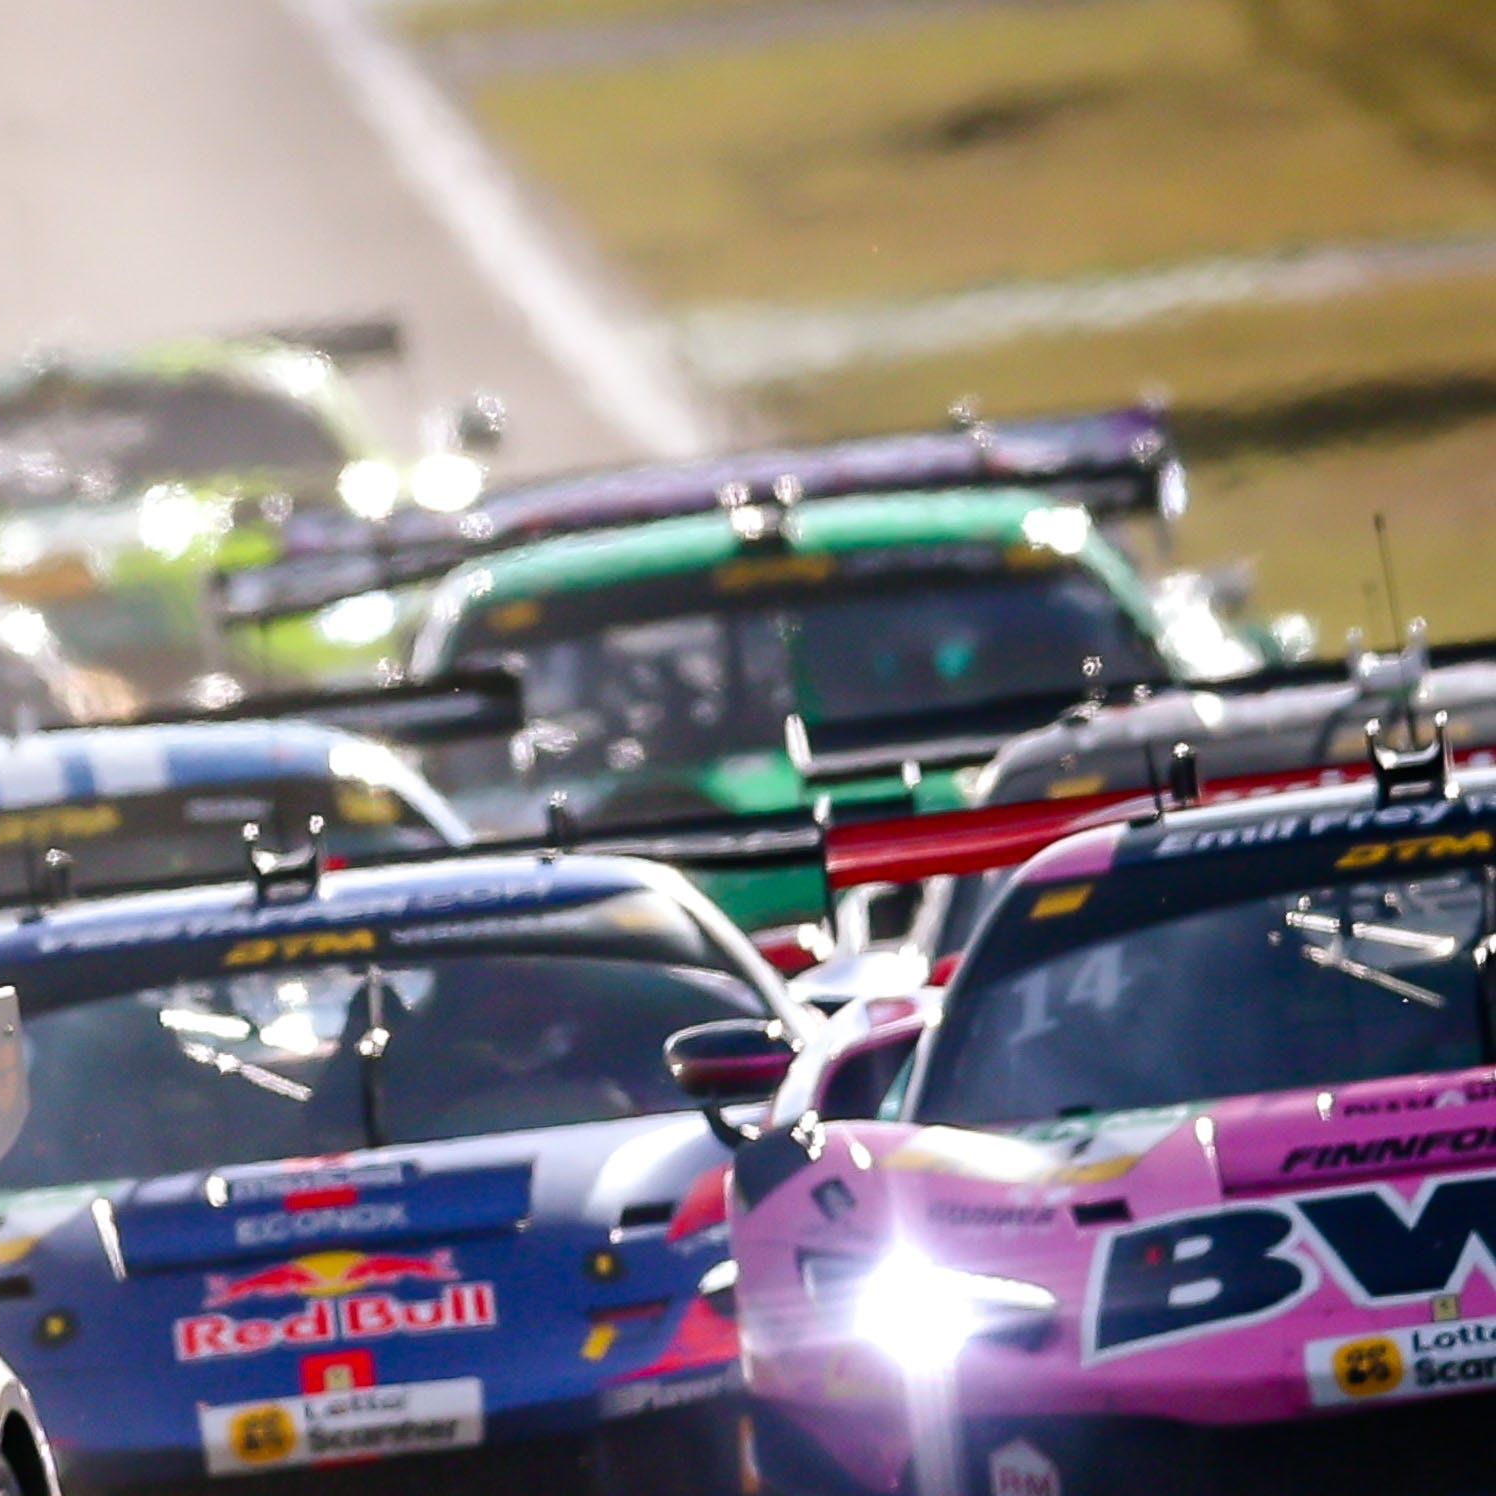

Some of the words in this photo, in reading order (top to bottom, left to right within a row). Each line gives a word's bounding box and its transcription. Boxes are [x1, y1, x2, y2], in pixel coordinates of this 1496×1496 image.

[1156, 815, 1301, 857] Emil
[1309, 795, 1457, 836] Frey
[1009, 944, 1135, 1045] 14
[175, 1299, 337, 1362] Red
[341, 1280, 497, 1342] Bull
